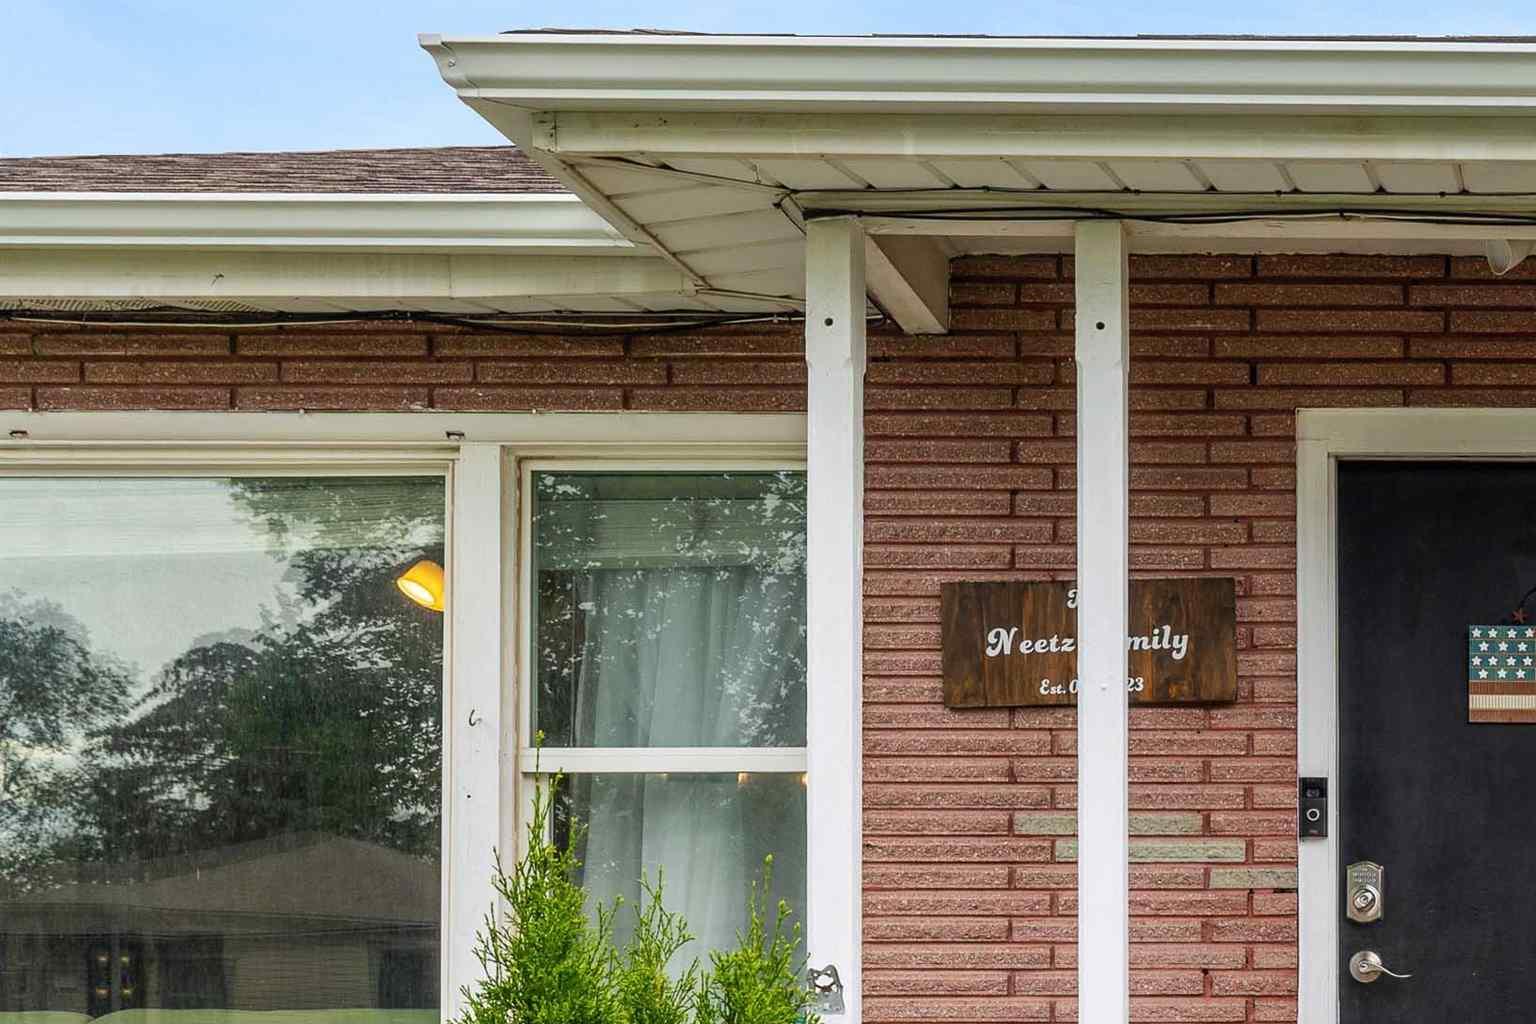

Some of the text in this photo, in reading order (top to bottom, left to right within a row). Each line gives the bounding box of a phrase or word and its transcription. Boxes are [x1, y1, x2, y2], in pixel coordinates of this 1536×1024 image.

[985, 624, 1189, 660] Neetz mily
[1039, 678, 1067, 696] Est.
